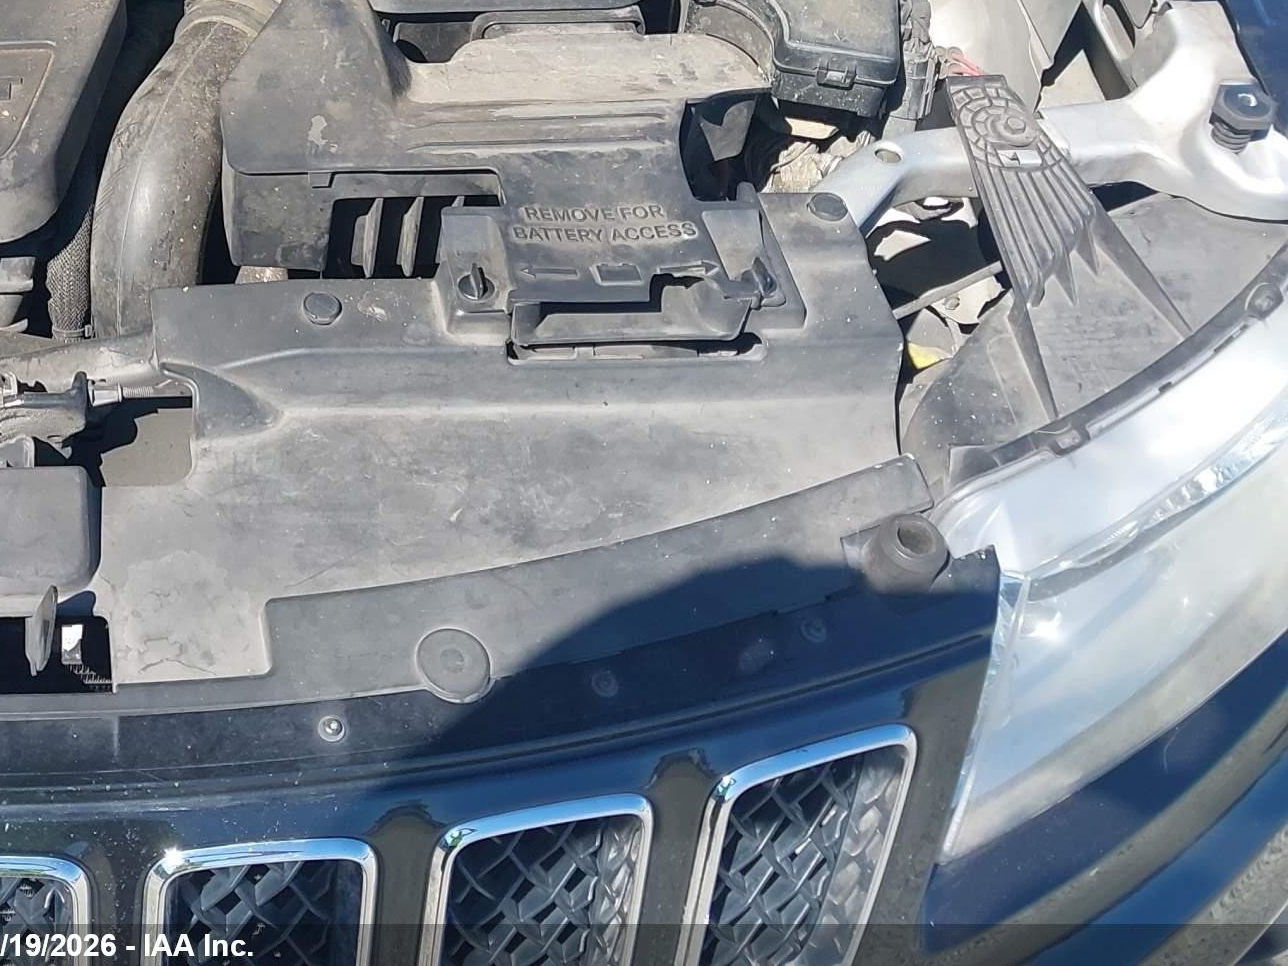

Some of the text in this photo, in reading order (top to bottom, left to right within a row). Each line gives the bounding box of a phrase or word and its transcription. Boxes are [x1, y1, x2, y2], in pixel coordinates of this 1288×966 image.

[523, 204, 665, 223] REMOVE FOR
[512, 222, 697, 243] BATTERY ACCESS
